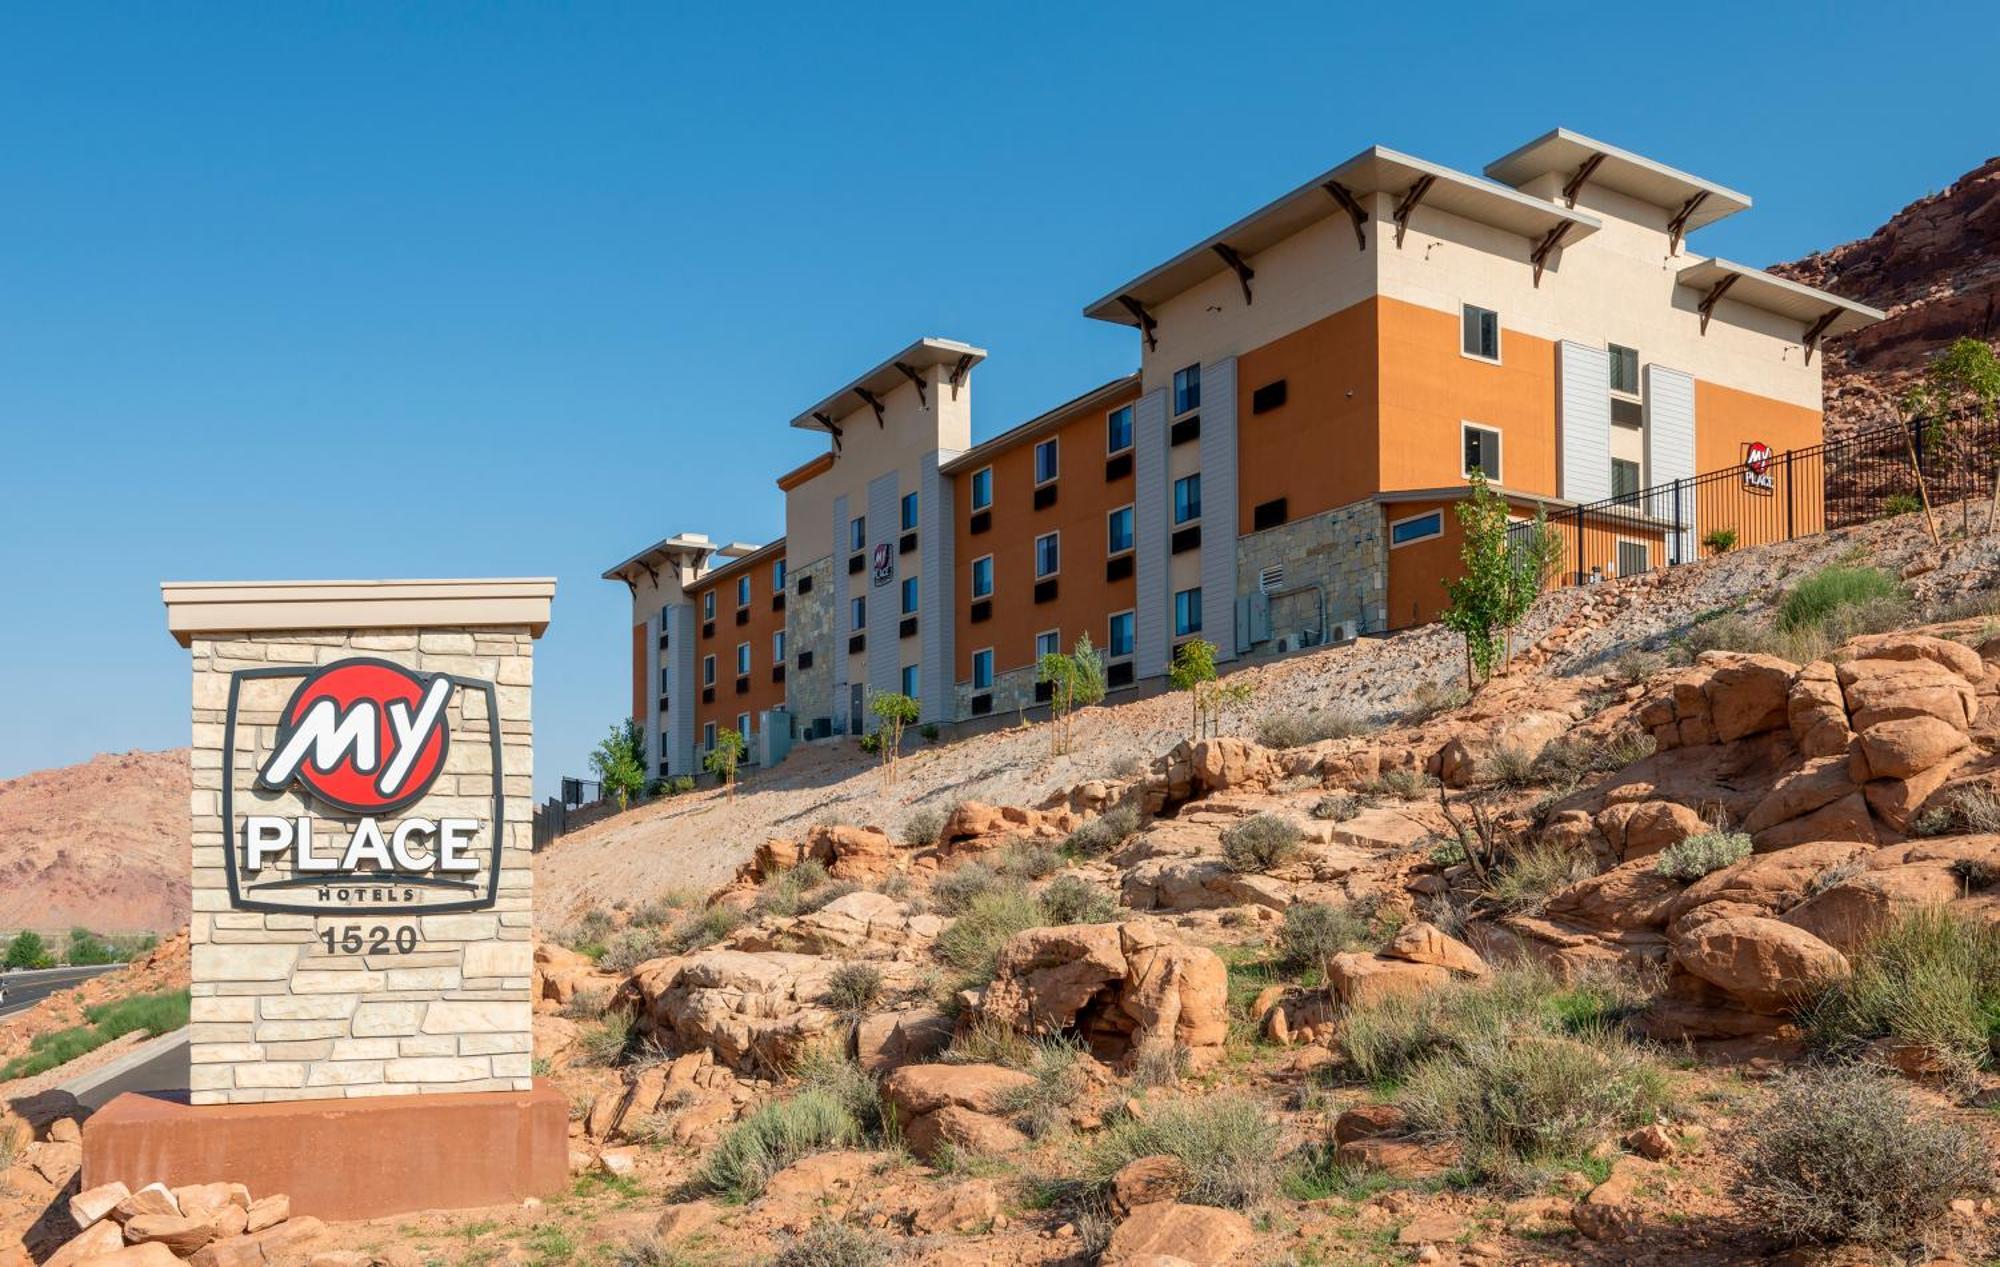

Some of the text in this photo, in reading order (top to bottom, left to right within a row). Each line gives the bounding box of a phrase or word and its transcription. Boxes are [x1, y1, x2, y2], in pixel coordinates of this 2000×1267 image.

[247, 816, 480, 871] PLACE
[318, 889, 414, 902] HOTELS
[320, 925, 417, 955] 1520
